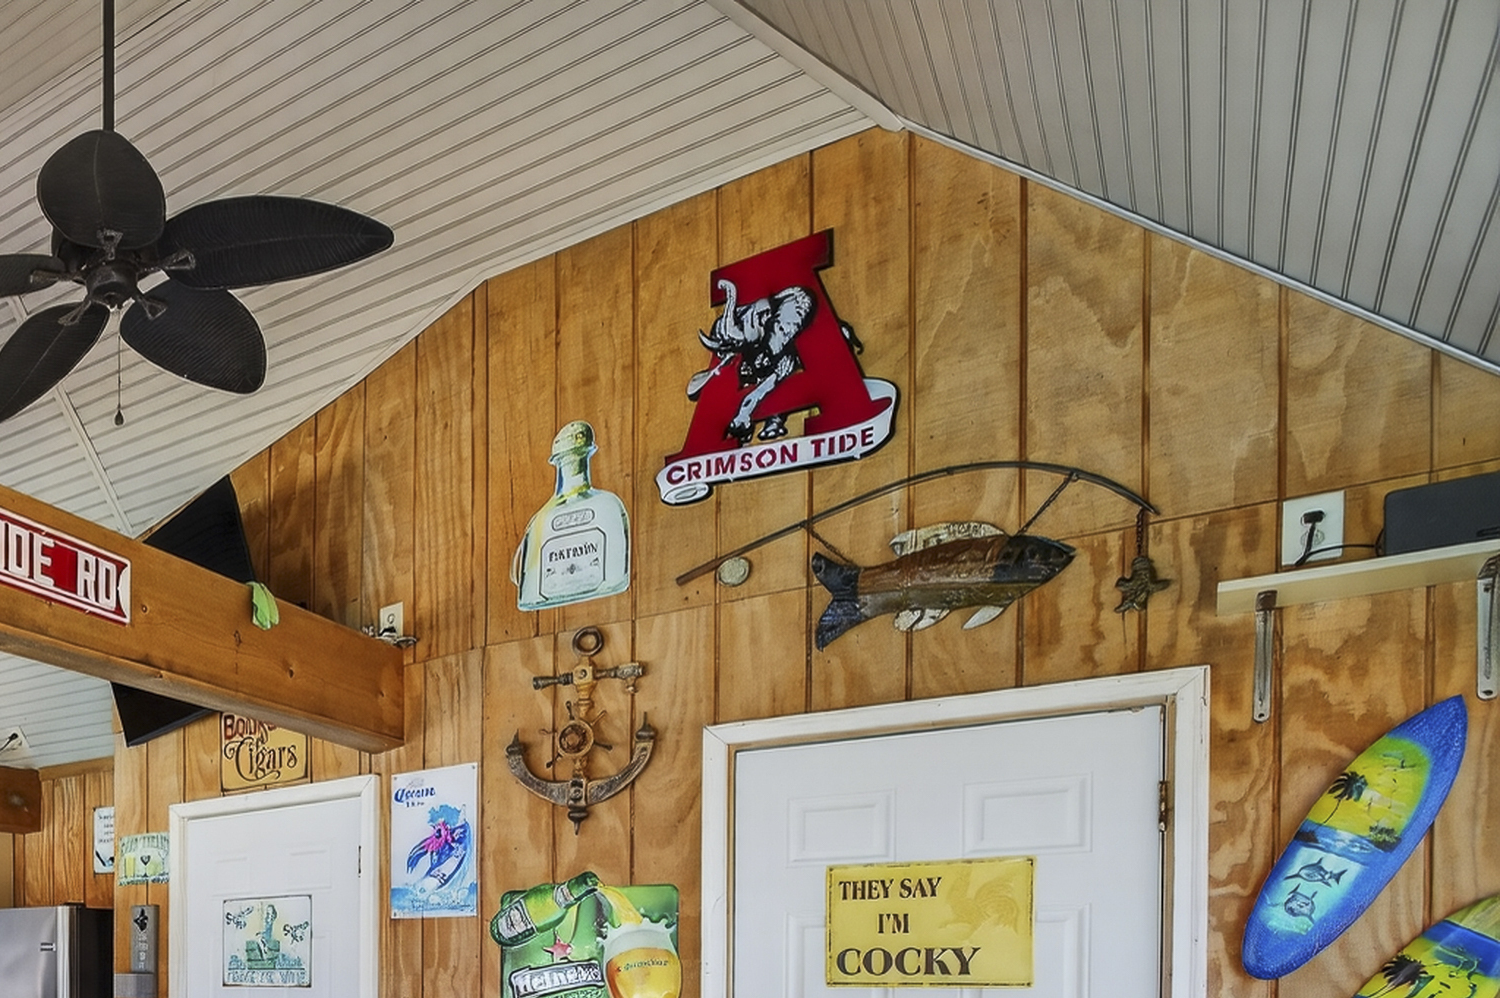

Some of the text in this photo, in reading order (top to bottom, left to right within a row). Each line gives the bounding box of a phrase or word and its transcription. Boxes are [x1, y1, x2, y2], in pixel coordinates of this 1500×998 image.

[665, 426, 876, 485] CRIMSON TIDE
[77, 550, 117, 611] RD
[223, 735, 299, 783] Cigars
[839, 876, 942, 901] THEY SAY
[878, 913, 910, 934] I'M
[836, 947, 982, 976] COCKY
